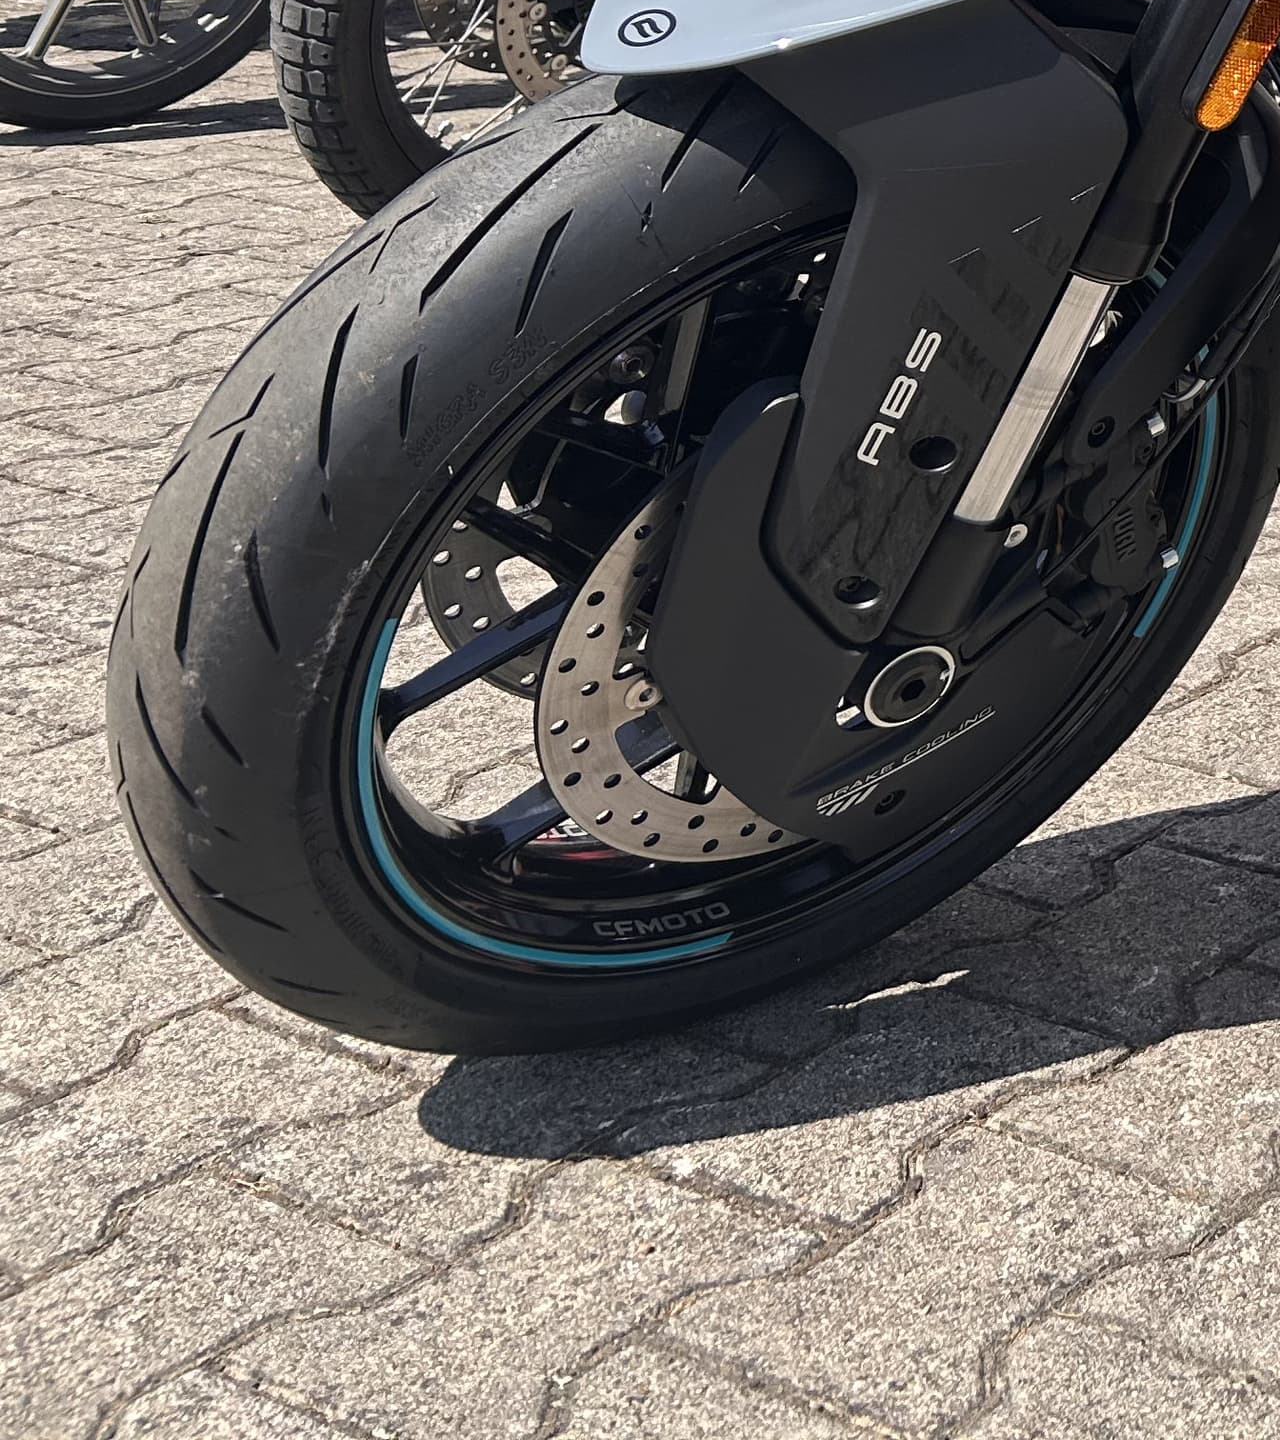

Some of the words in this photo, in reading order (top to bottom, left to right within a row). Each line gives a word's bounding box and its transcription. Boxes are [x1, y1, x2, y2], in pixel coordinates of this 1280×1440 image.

[856, 327, 943, 466] ABS
[816, 761, 897, 808] BRAKE
[902, 704, 994, 764] COOLING
[593, 901, 731, 938] CFMOTO
